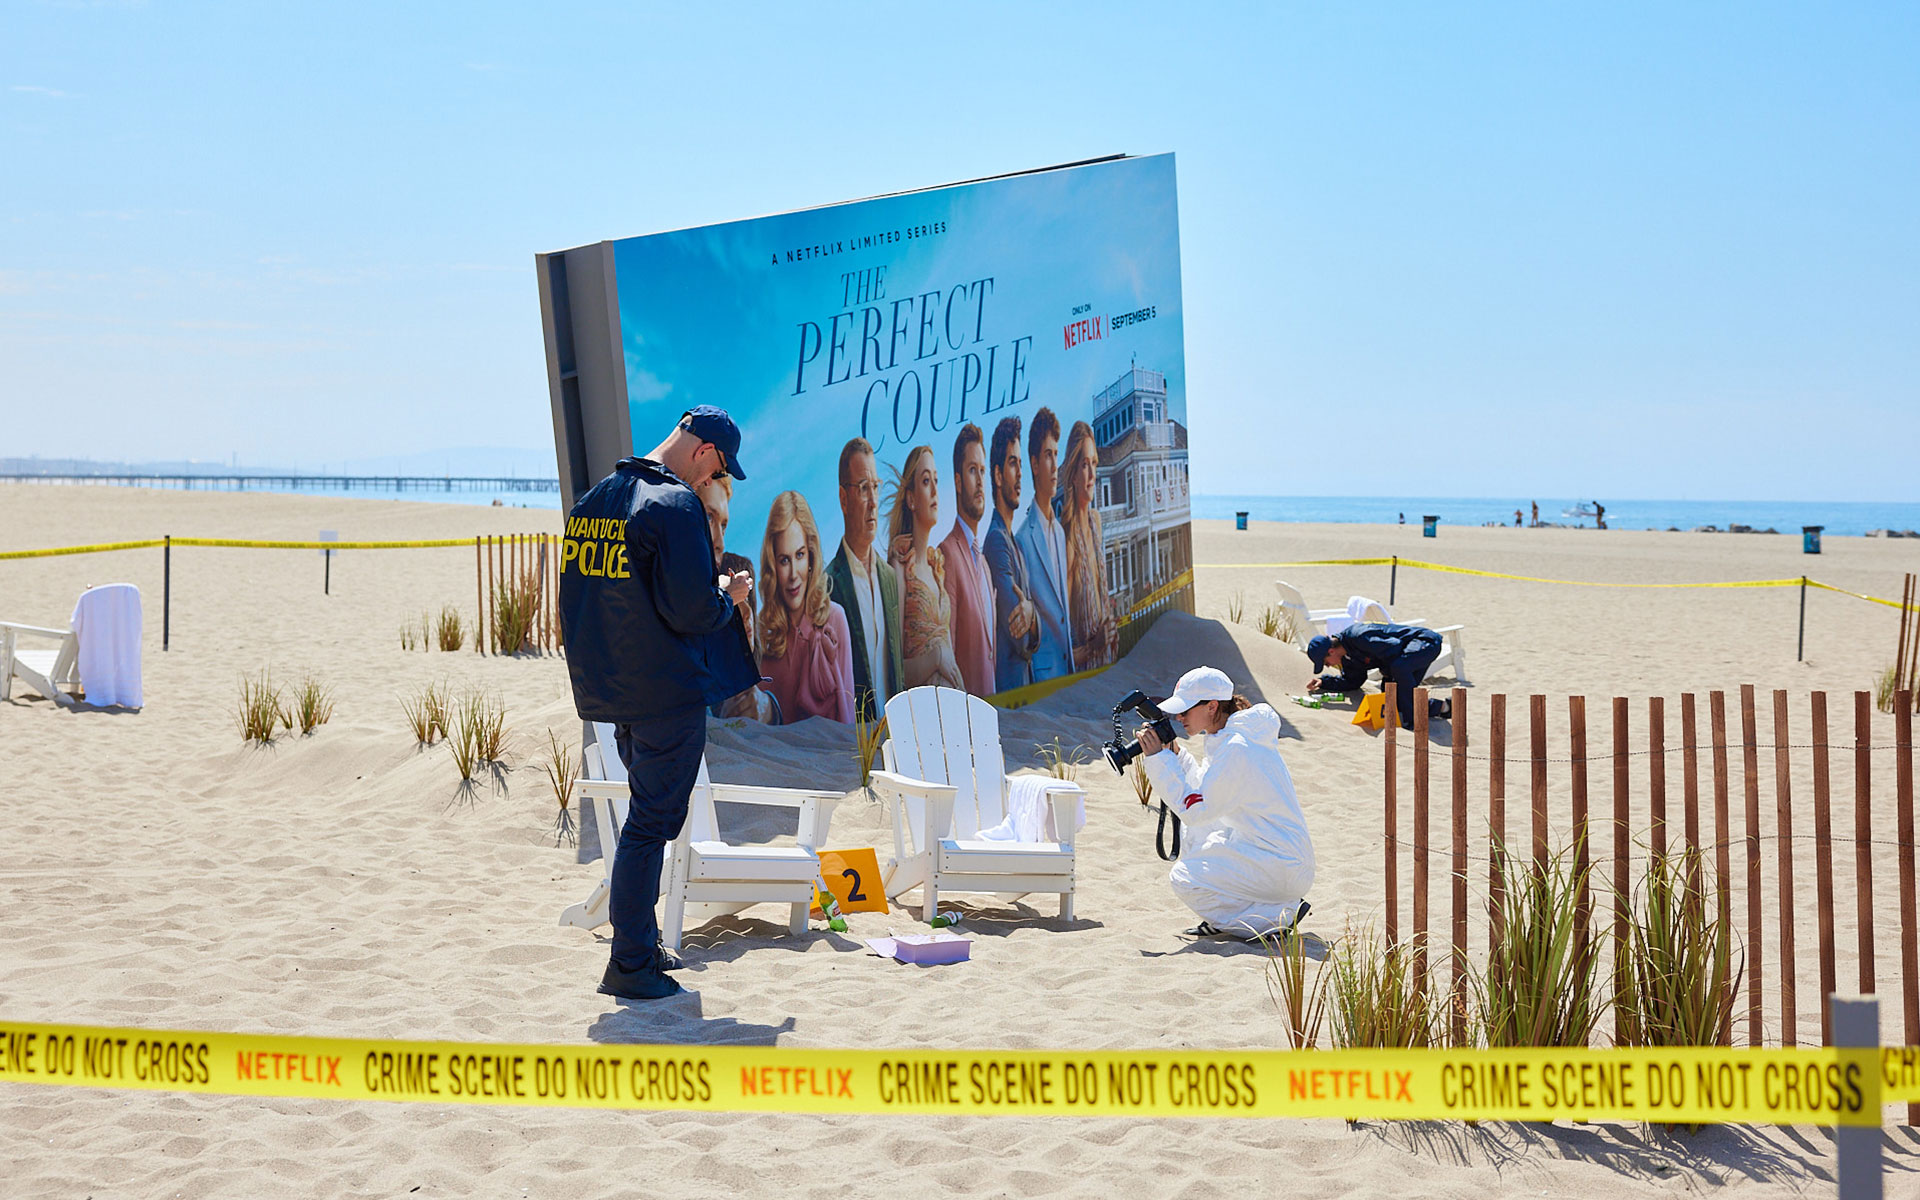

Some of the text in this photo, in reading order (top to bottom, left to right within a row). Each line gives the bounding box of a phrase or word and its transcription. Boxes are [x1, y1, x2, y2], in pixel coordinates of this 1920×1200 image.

[771, 221, 947, 265] A NETFLIX LIMITED SERIES
[840, 265, 887, 308] THE
[1072, 303, 1092, 316] ONLY ON
[1111, 306, 1156, 330] SEPTEMBER 5
[791, 277, 994, 396] PERFECT
[1063, 315, 1102, 350] NETFLIX
[861, 335, 1033, 455] COUPLE
[560, 539, 631, 579] POLICE
[842, 868, 866, 902] 2
[45, 1034, 74, 1076] DO
[84, 1036, 128, 1078] NOT
[134, 1039, 210, 1084] CROSS
[237, 1050, 341, 1086] NETFLIX
[364, 1050, 438, 1095] CRIME
[448, 1054, 525, 1097] SCENE
[535, 1057, 566, 1099] DO
[576, 1057, 621, 1100] NOT
[631, 1059, 712, 1102] CROSS
[740, 1065, 854, 1099] NETFLIX
[878, 1061, 960, 1105] CRIME
[970, 1061, 1054, 1106] SCENE
[1063, 1062, 1097, 1106] DO
[1107, 1062, 1158, 1106] NOT
[1168, 1062, 1256, 1108] CROSS
[1288, 1069, 1414, 1104] NETFLIX
[1441, 1062, 1530, 1109] CRIME
[1542, 1062, 1634, 1108] SCENE
[1647, 1062, 1685, 1109] DO
[1696, 1062, 1752, 1110] NOT
[1764, 1062, 1863, 1112] CROSS
